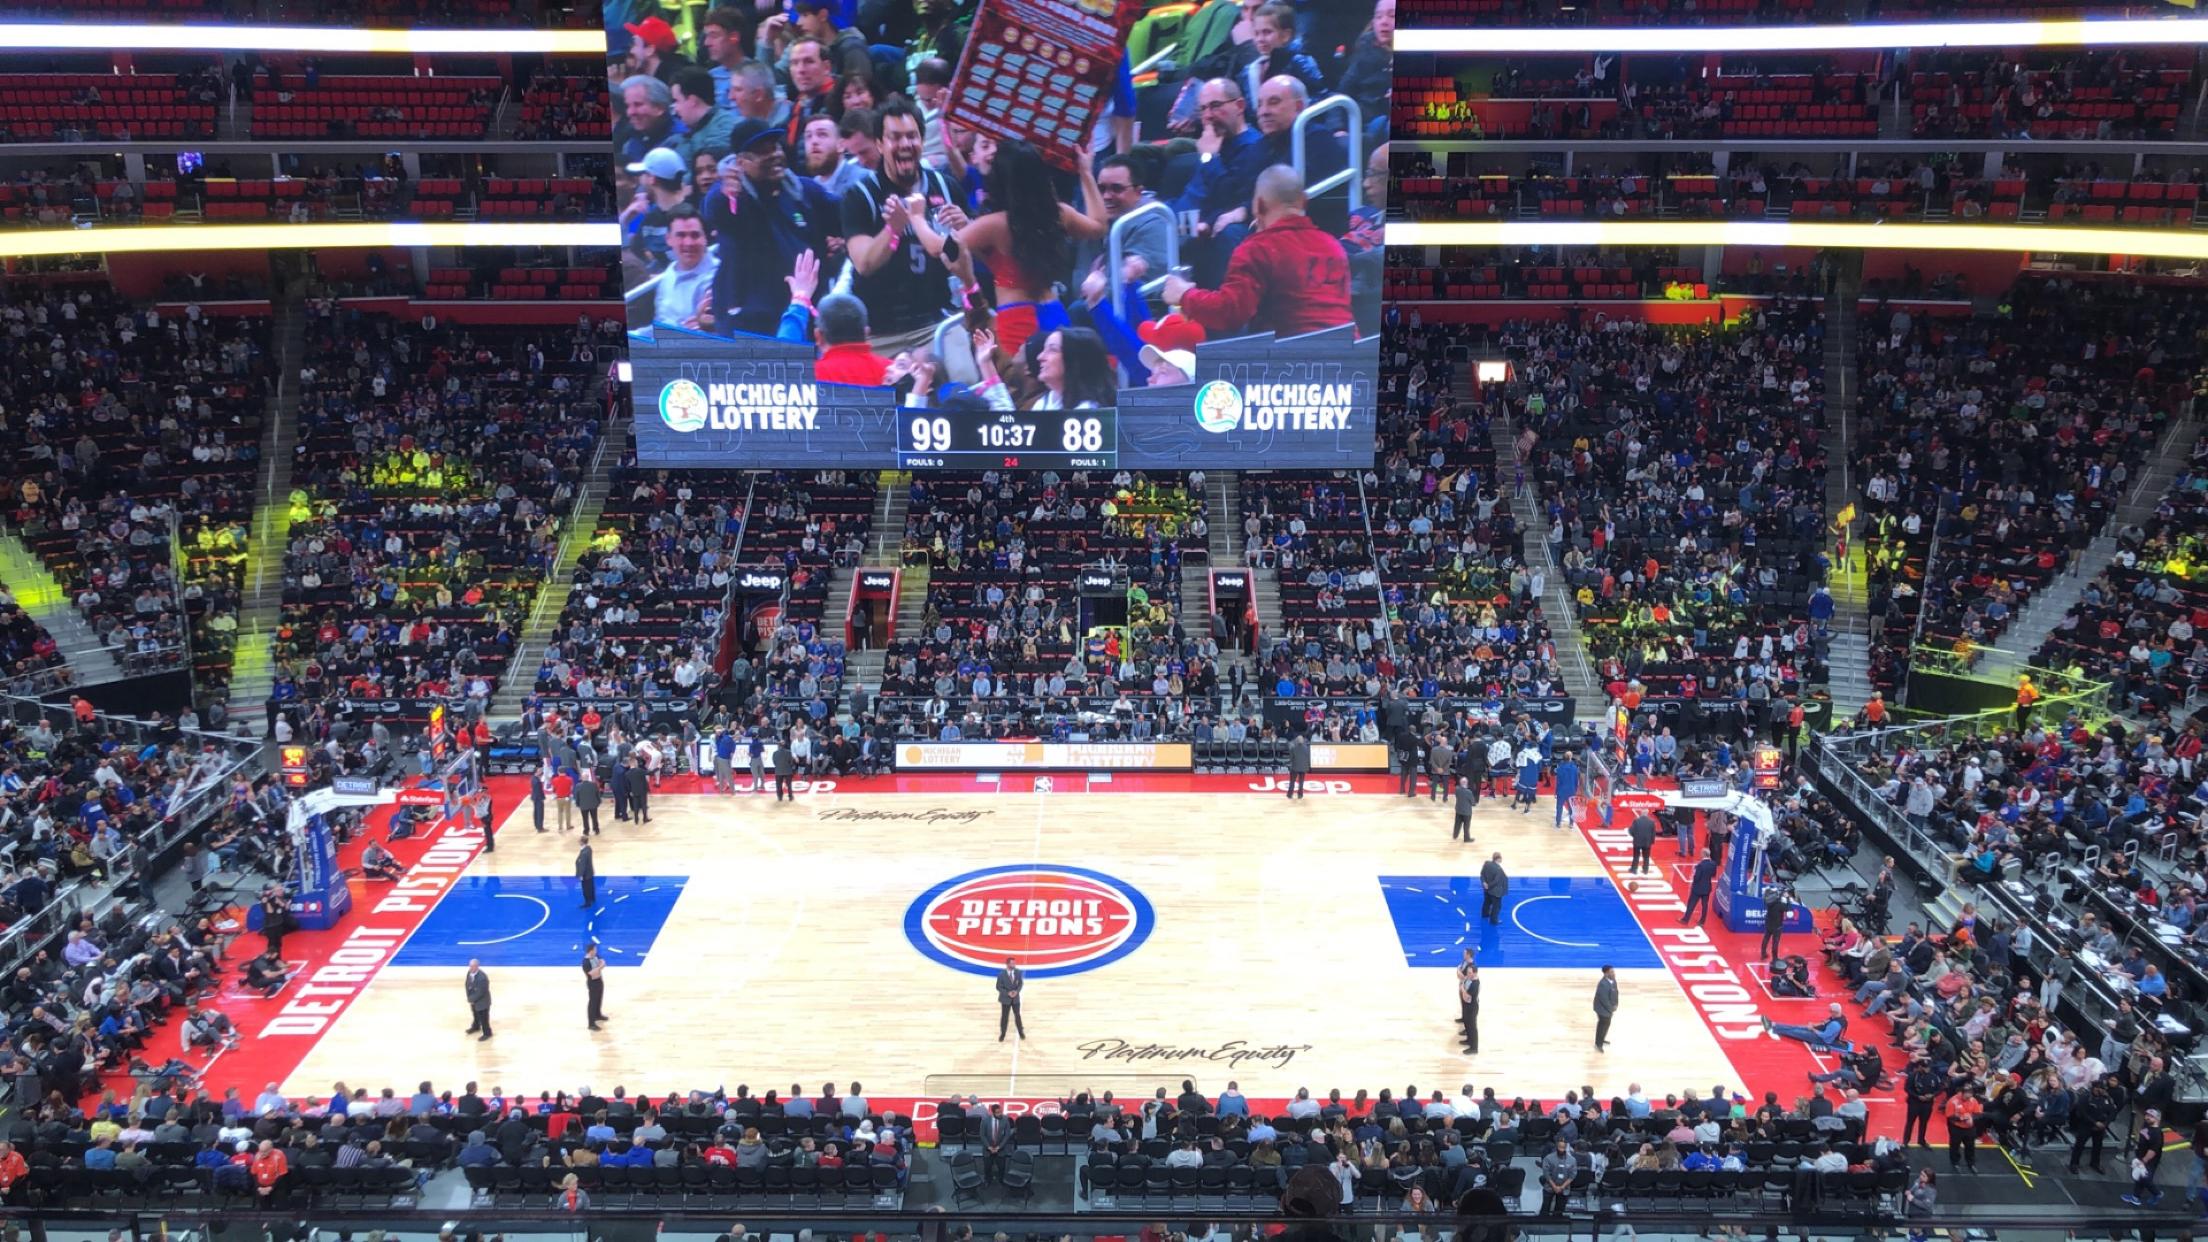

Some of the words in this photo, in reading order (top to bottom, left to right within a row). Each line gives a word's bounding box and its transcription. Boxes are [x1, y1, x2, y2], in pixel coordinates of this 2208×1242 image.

[708, 383, 818, 405] MICHIGAN
[1243, 383, 1352, 406] MICHIGAN
[709, 406, 820, 430] LOTTERY
[999, 414, 1015, 424] 4th
[1243, 406, 1352, 430] LOTTERY
[911, 417, 951, 451] 99
[977, 425, 1037, 447] 10:37
[1062, 418, 1102, 451] 88
[906, 458, 935, 467] FOULS:
[1004, 458, 1018, 467] 24
[1071, 458, 1100, 467] FOULS:
[740, 574, 781, 589] Jeep
[863, 576, 891, 587] Jeep
[1084, 576, 1111, 587] Jeep
[1217, 576, 1244, 587] Jeep
[734, 777, 837, 795] Jeep
[1248, 776, 1352, 795] Jeep
[1687, 783, 1723, 792] DETROIT
[371, 826, 488, 915] PISTONS
[959, 899, 1103, 917] DETROIT
[956, 917, 1103, 936] PISTONS
[257, 925, 407, 1040] DETROIT
[1652, 925, 1780, 1041] PISTONS
[1076, 1038, 1211, 1063] Platinum
[1208, 1040, 1313, 1069] Equity
